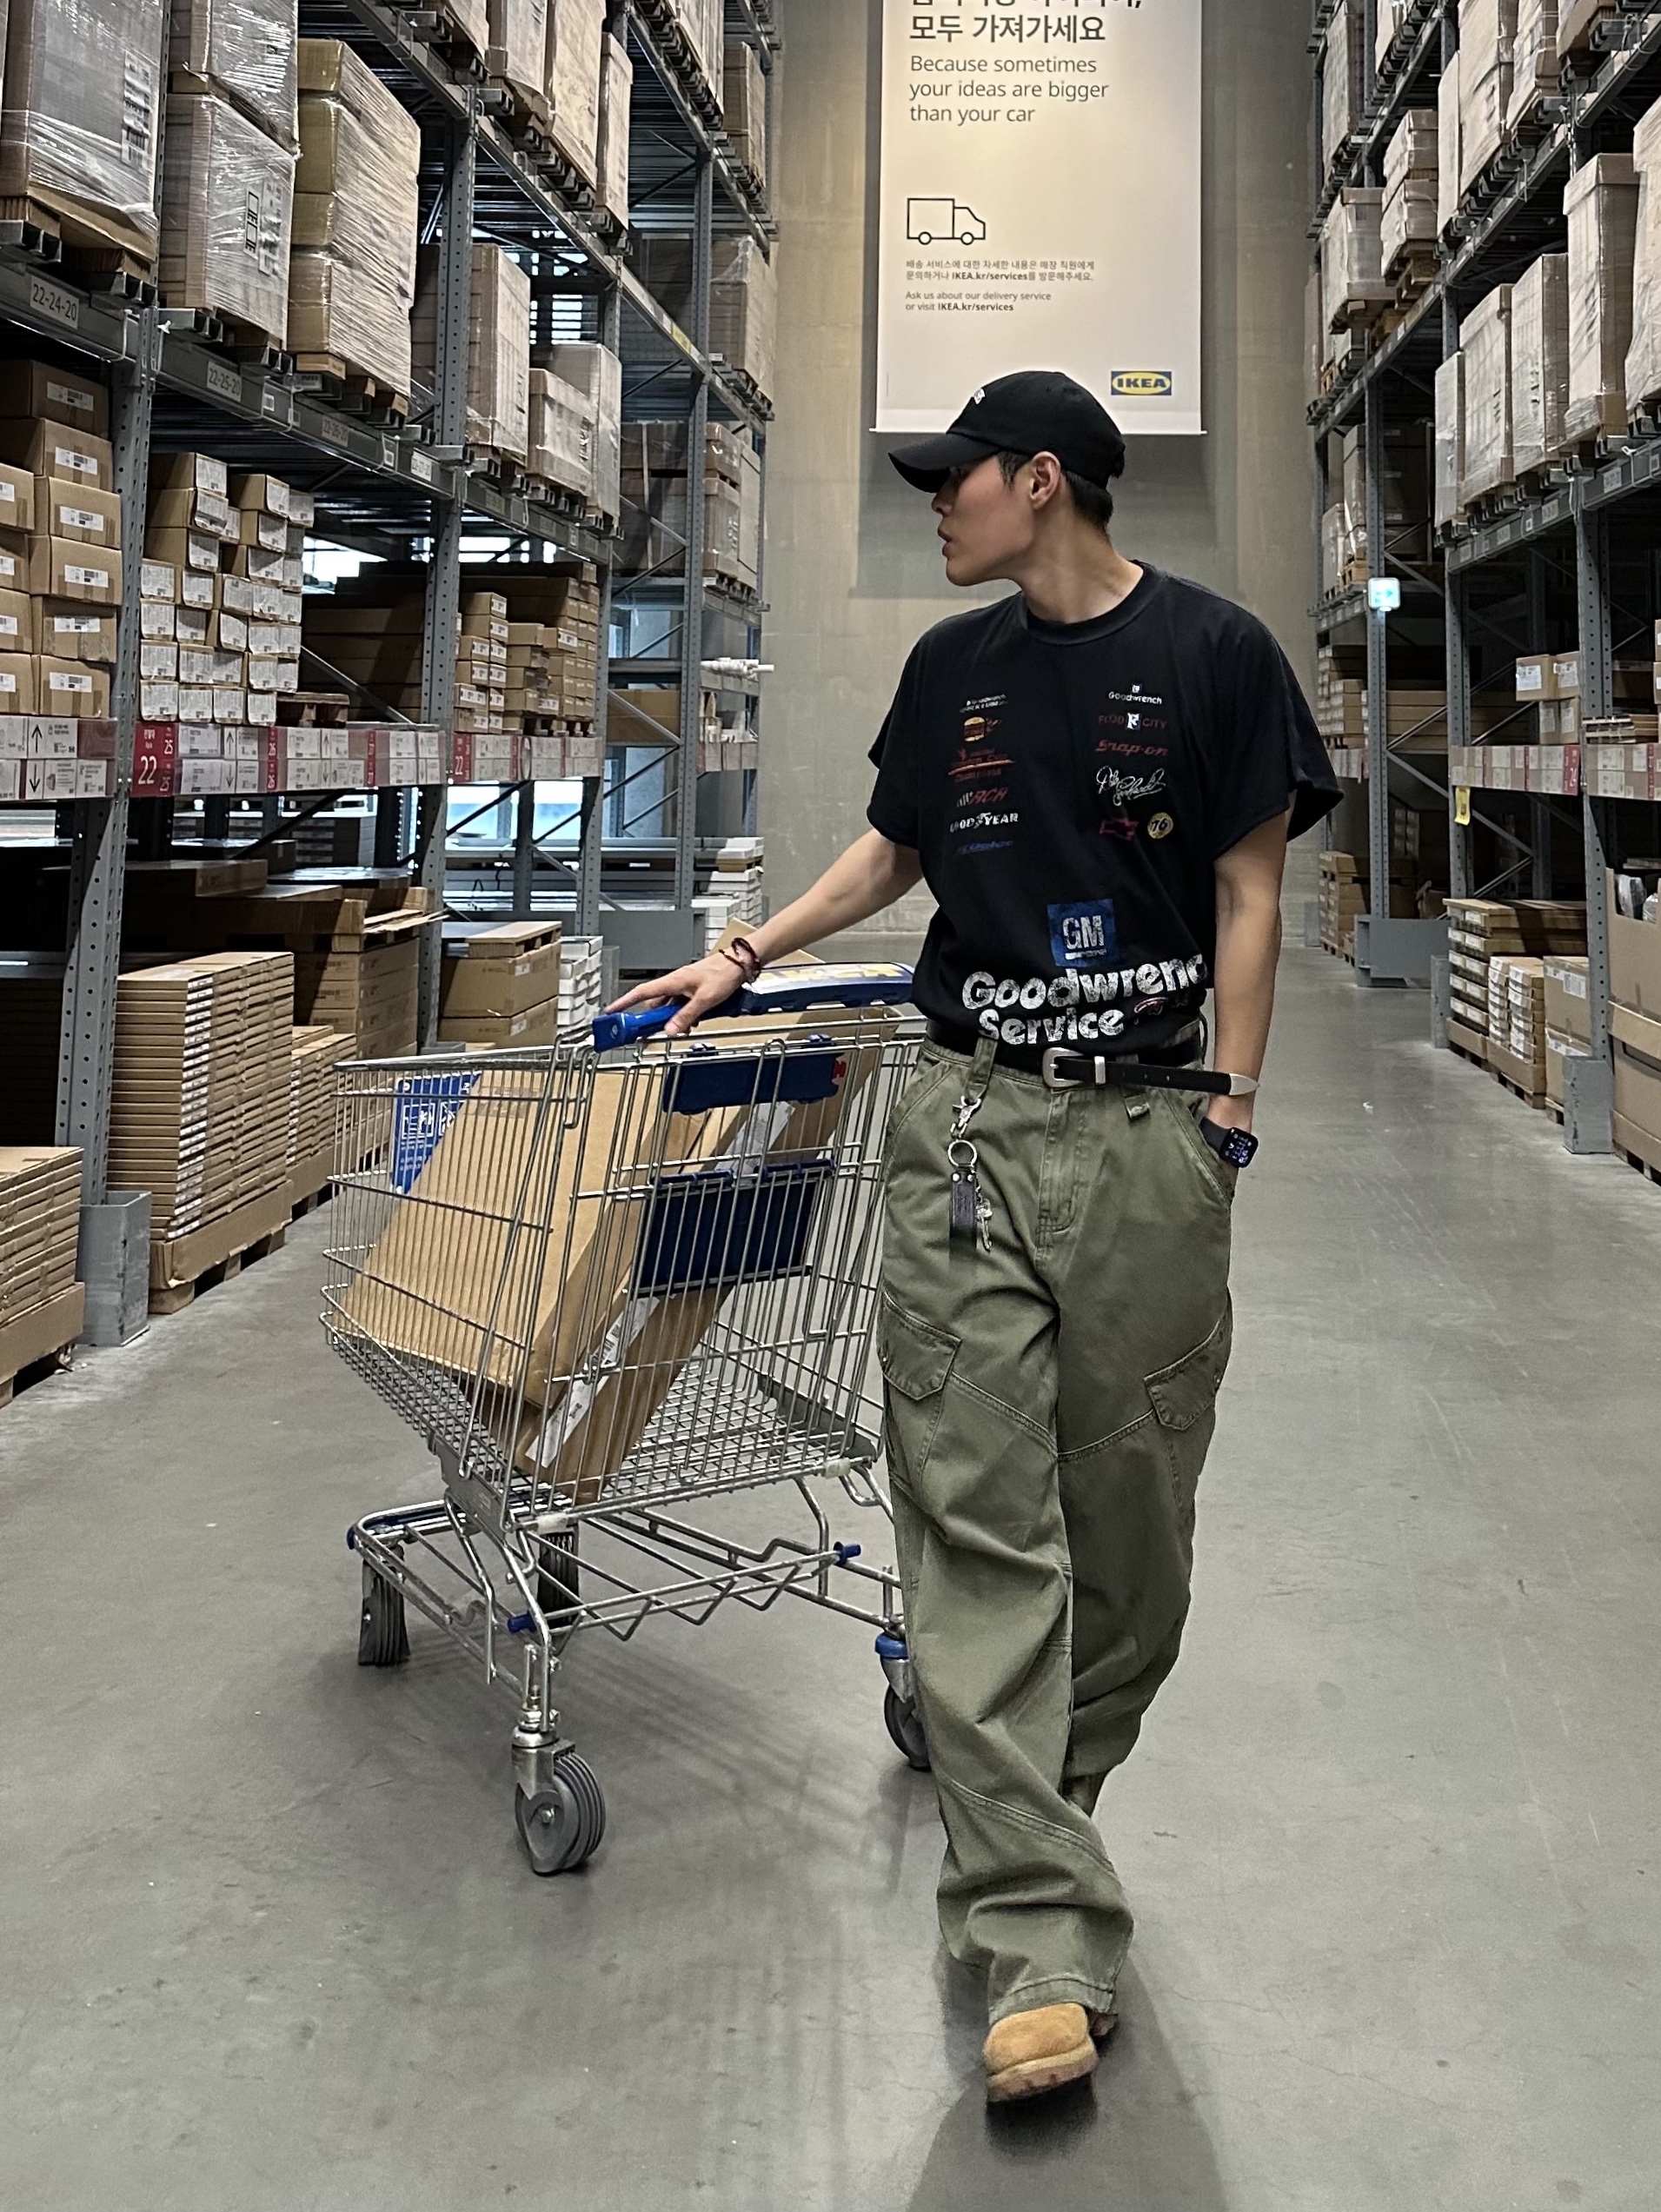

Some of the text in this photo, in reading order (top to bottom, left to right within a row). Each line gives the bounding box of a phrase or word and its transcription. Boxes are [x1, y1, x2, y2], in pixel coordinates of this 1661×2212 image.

[909, 14, 1106, 43] 모두 가져가세요
[910, 56, 1098, 73] Because sometimes
[909, 80, 1109, 102] your ideas are bigger
[910, 104, 1035, 126] than your car
[906, 260, 923, 269] 배송
[927, 260, 960, 269] 서비스에
[963, 260, 980, 269] 대한
[983, 260, 1009, 269] 자세한
[1011, 260, 1037, 269] 내용은
[1060, 261, 1094, 270] 직원에게
[906, 270, 949, 281] 문의하거나
[32, 283, 77, 322] 22-24-20
[905, 291, 921, 300] Ask
[936, 291, 963, 300] about
[982, 291, 1018, 302] delivery
[1020, 292, 1052, 301] service
[917, 302, 935, 311] visit
[937, 302, 1014, 311] IKEA.kr/services
[209, 367, 242, 397] 22-25-20
[1117, 377, 1166, 389] IKEA
[1108, 691, 1163, 705] Goodwrench
[1098, 714, 1167, 728] FOOD CITY
[137, 755, 157, 785] 22
[1151, 816, 1167, 830] 76
[1062, 914, 1106, 950] GM
[961, 953, 1208, 1010] Goodwrenc
[978, 1007, 1126, 1045] Service
